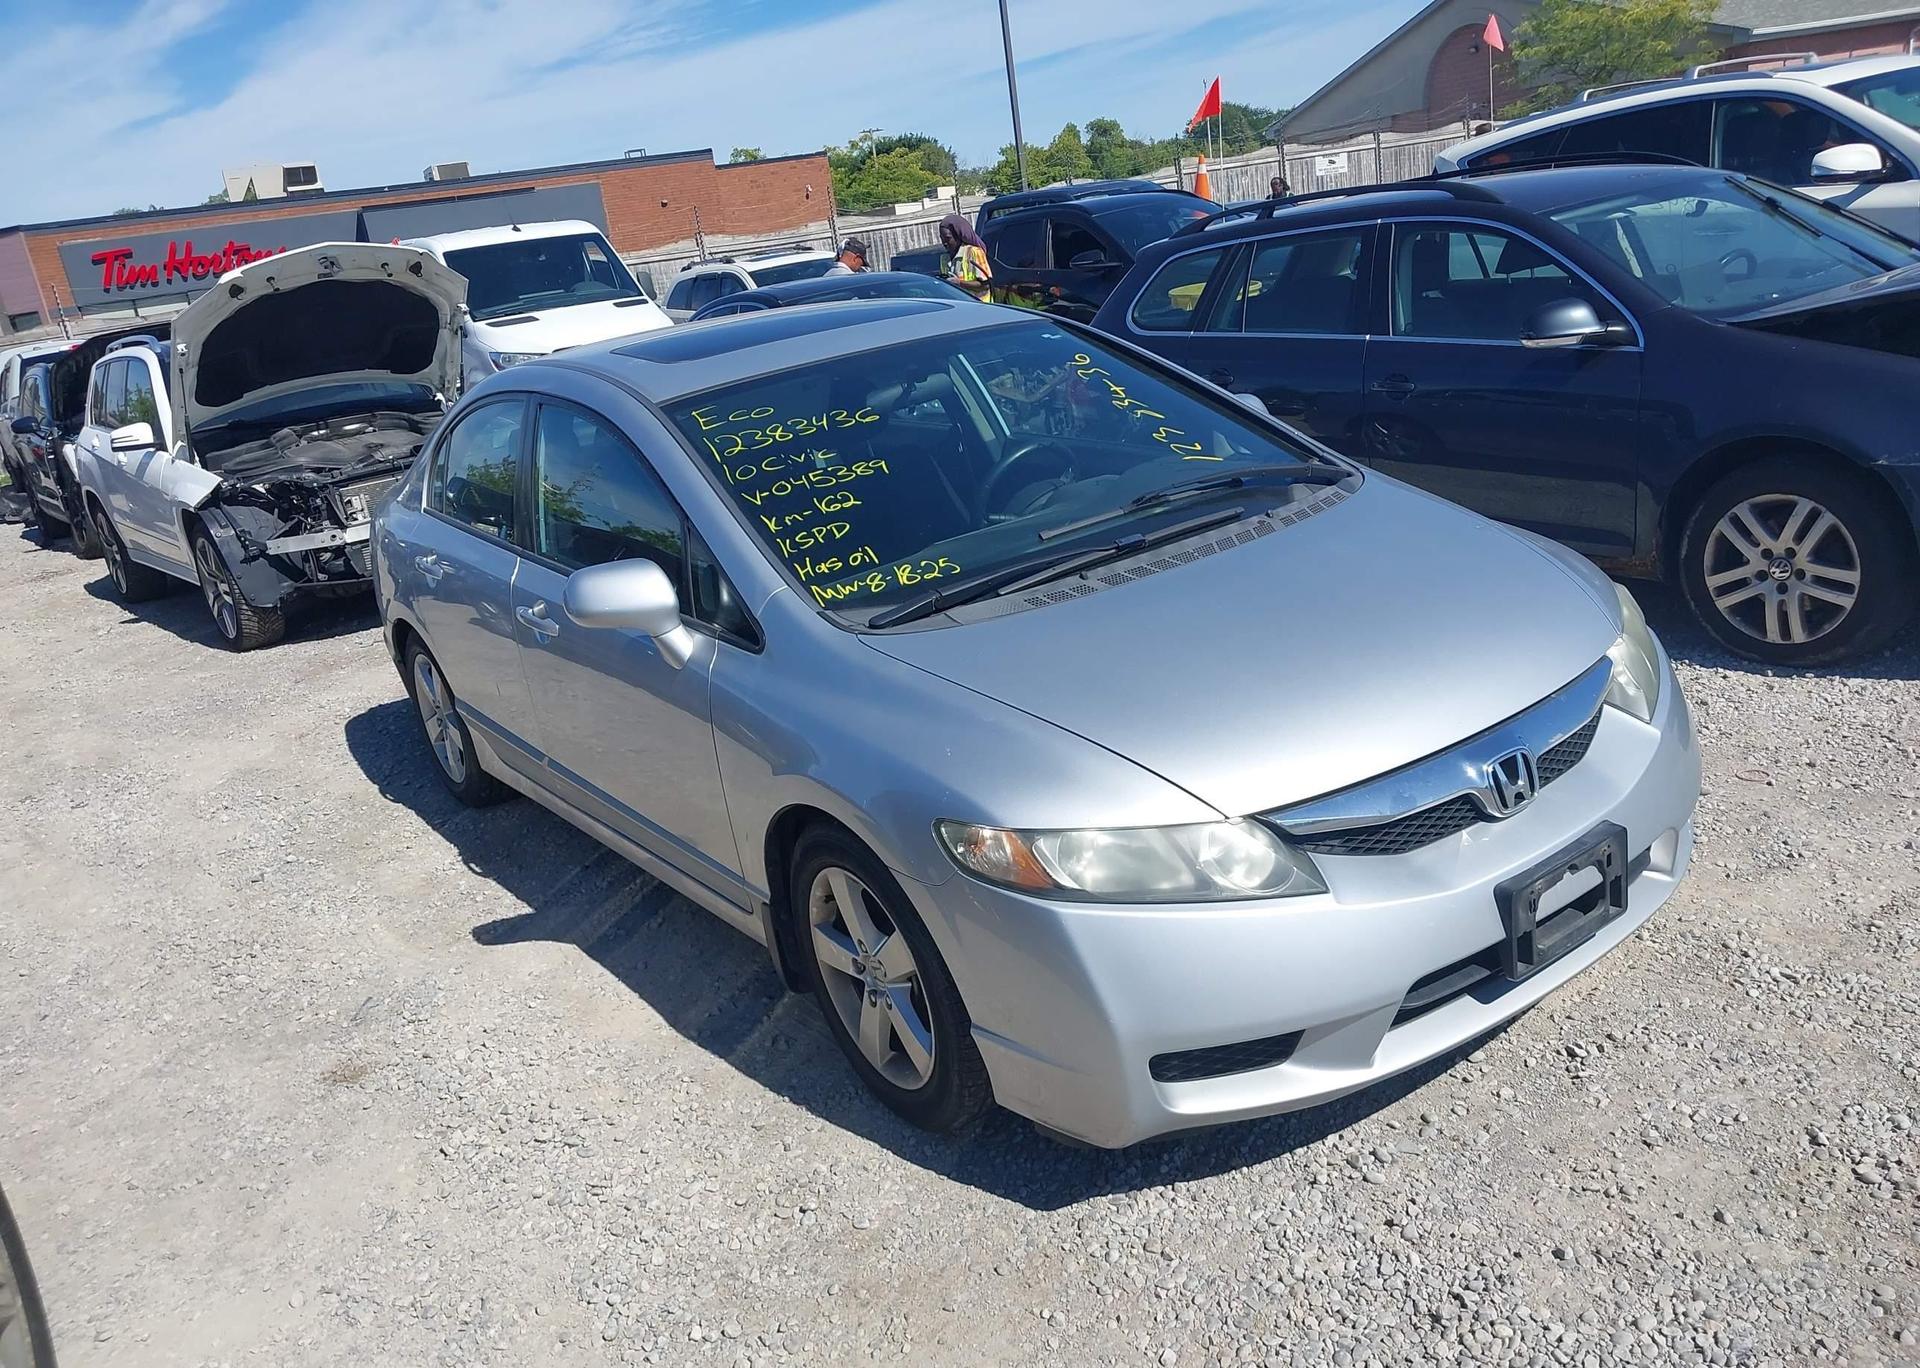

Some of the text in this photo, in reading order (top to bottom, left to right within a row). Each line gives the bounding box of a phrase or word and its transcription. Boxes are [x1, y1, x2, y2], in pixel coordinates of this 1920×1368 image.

[91, 240, 287, 291] Tim Horto
[691, 405, 775, 430] Eco
[702, 407, 881, 463] 12383436
[794, 545, 880, 582] Has oil
